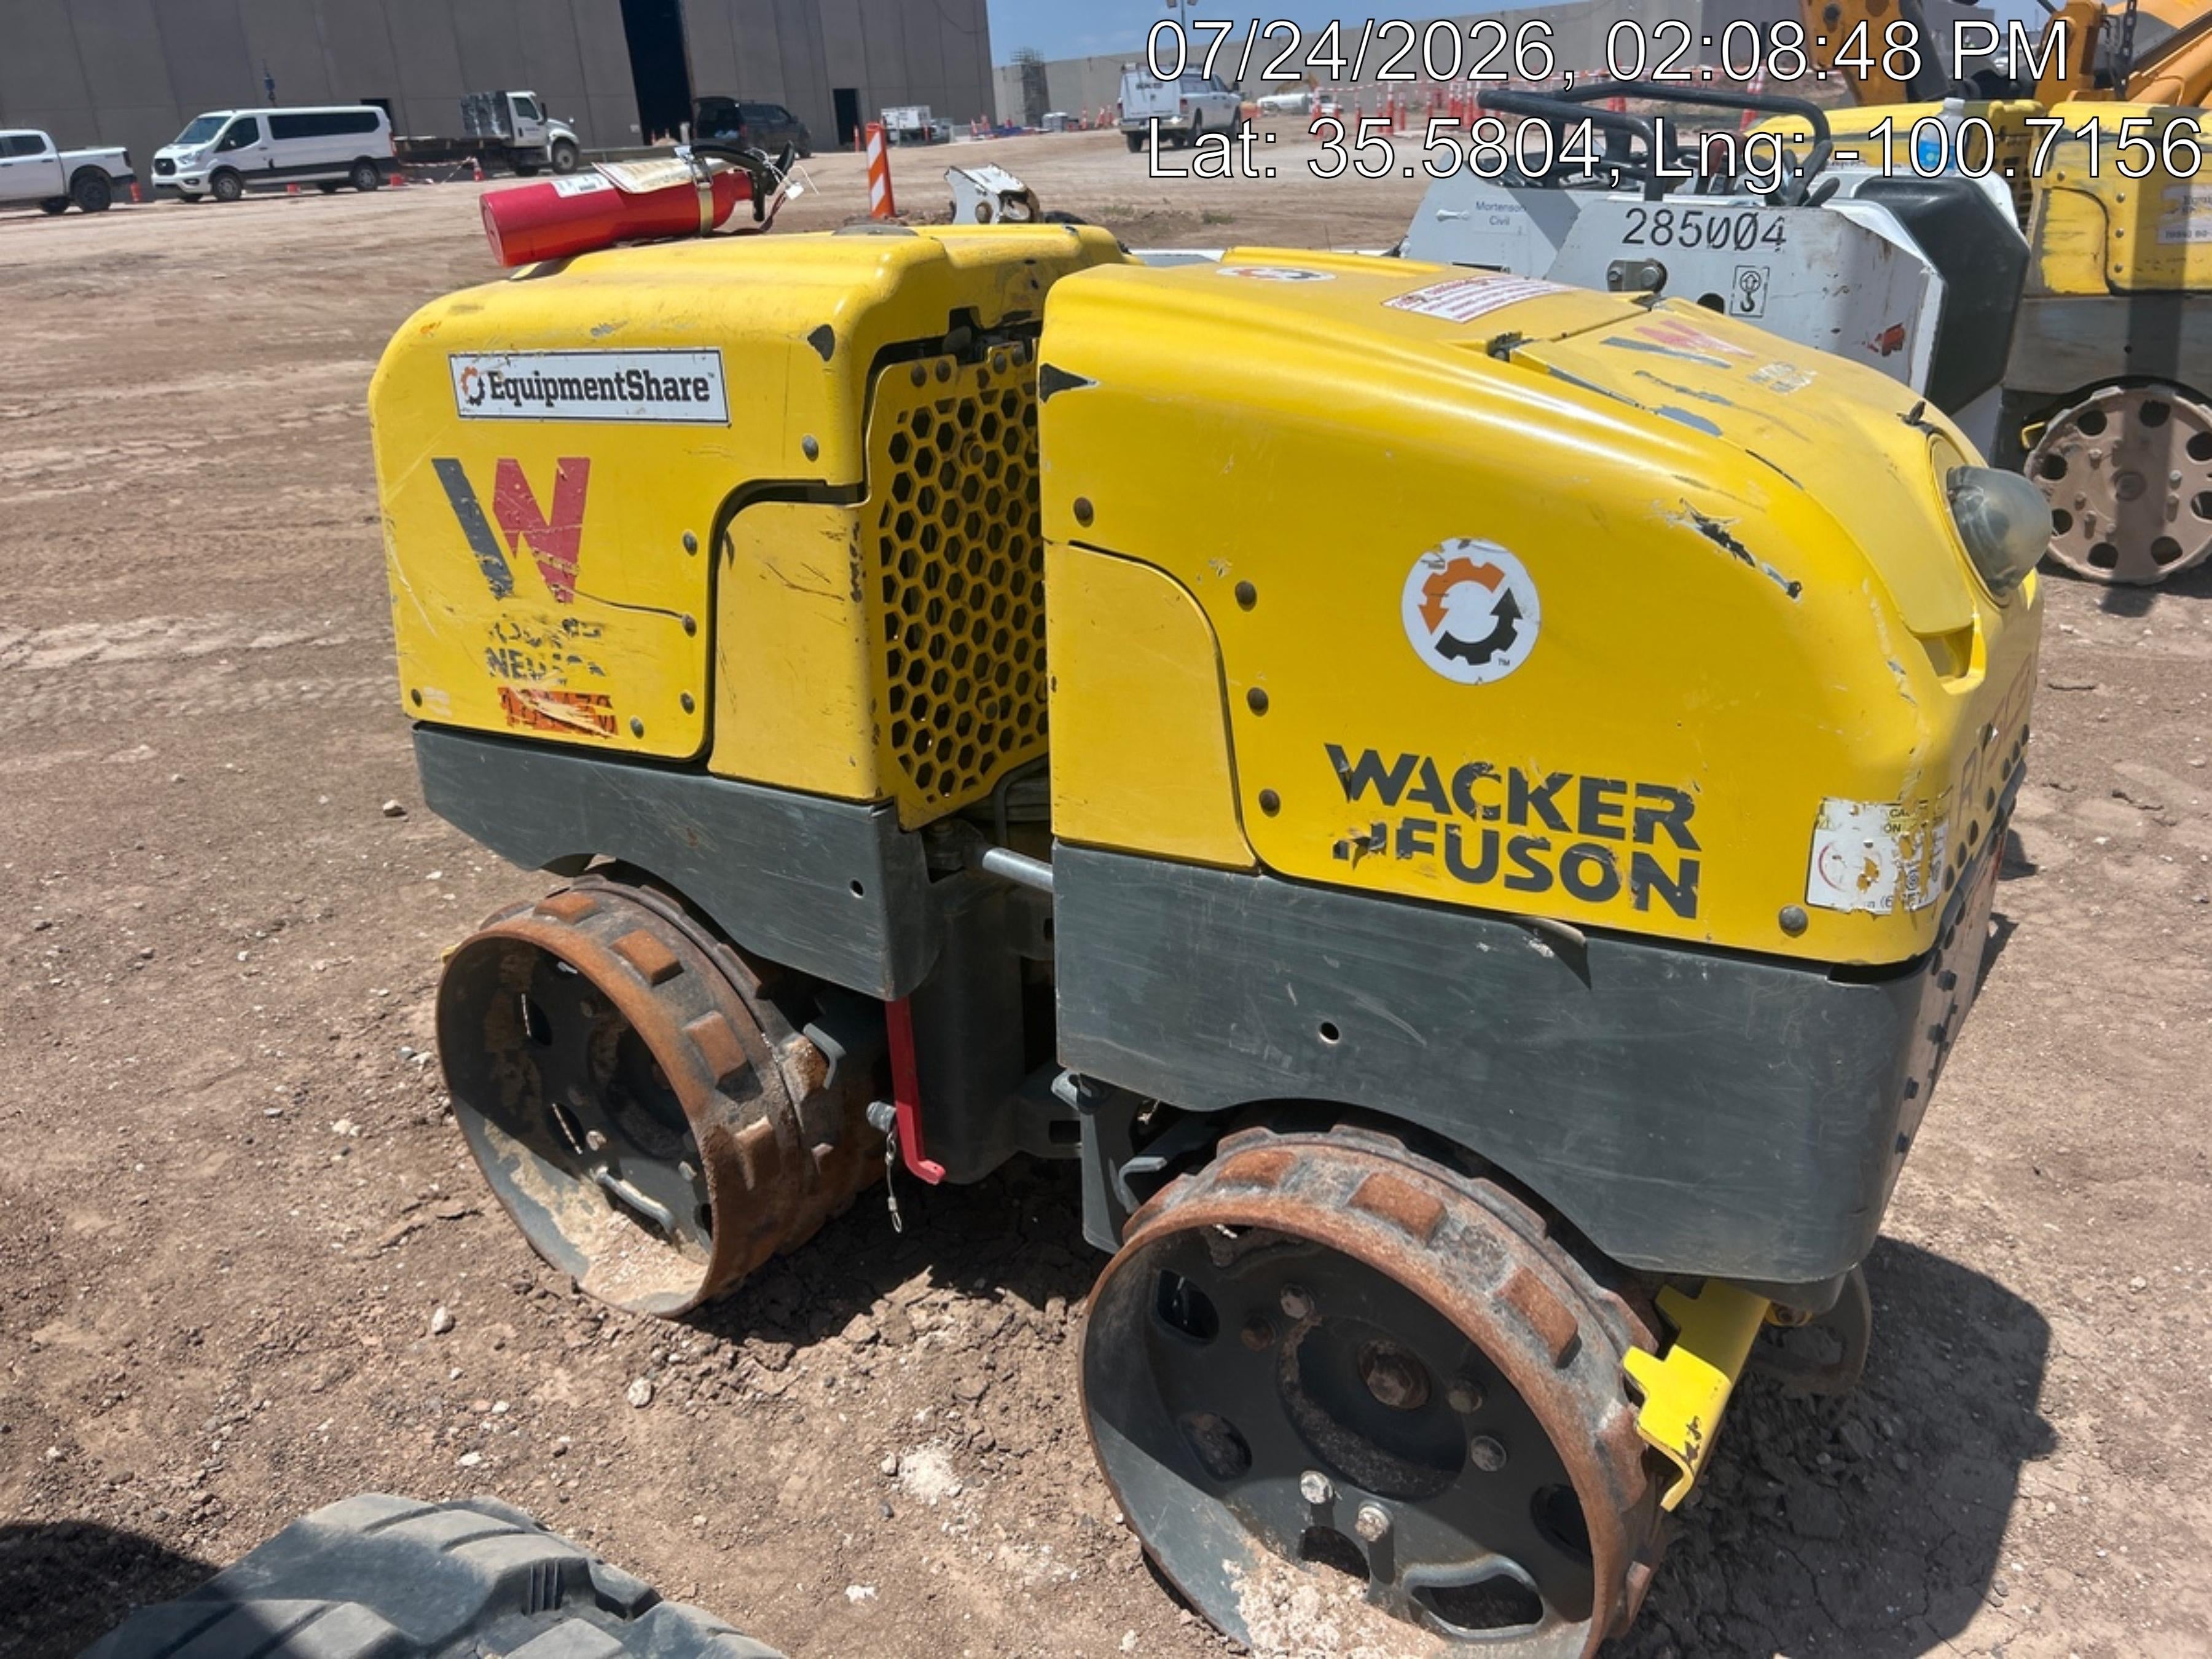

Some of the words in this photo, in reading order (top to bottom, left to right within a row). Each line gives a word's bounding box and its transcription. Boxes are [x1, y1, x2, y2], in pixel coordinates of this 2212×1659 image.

[1475, 200, 1527, 213] Mortenson
[1489, 215, 1511, 226] Civil
[488, 369, 711, 407] EquipmentShare
[1324, 742, 1702, 852] WACKER
